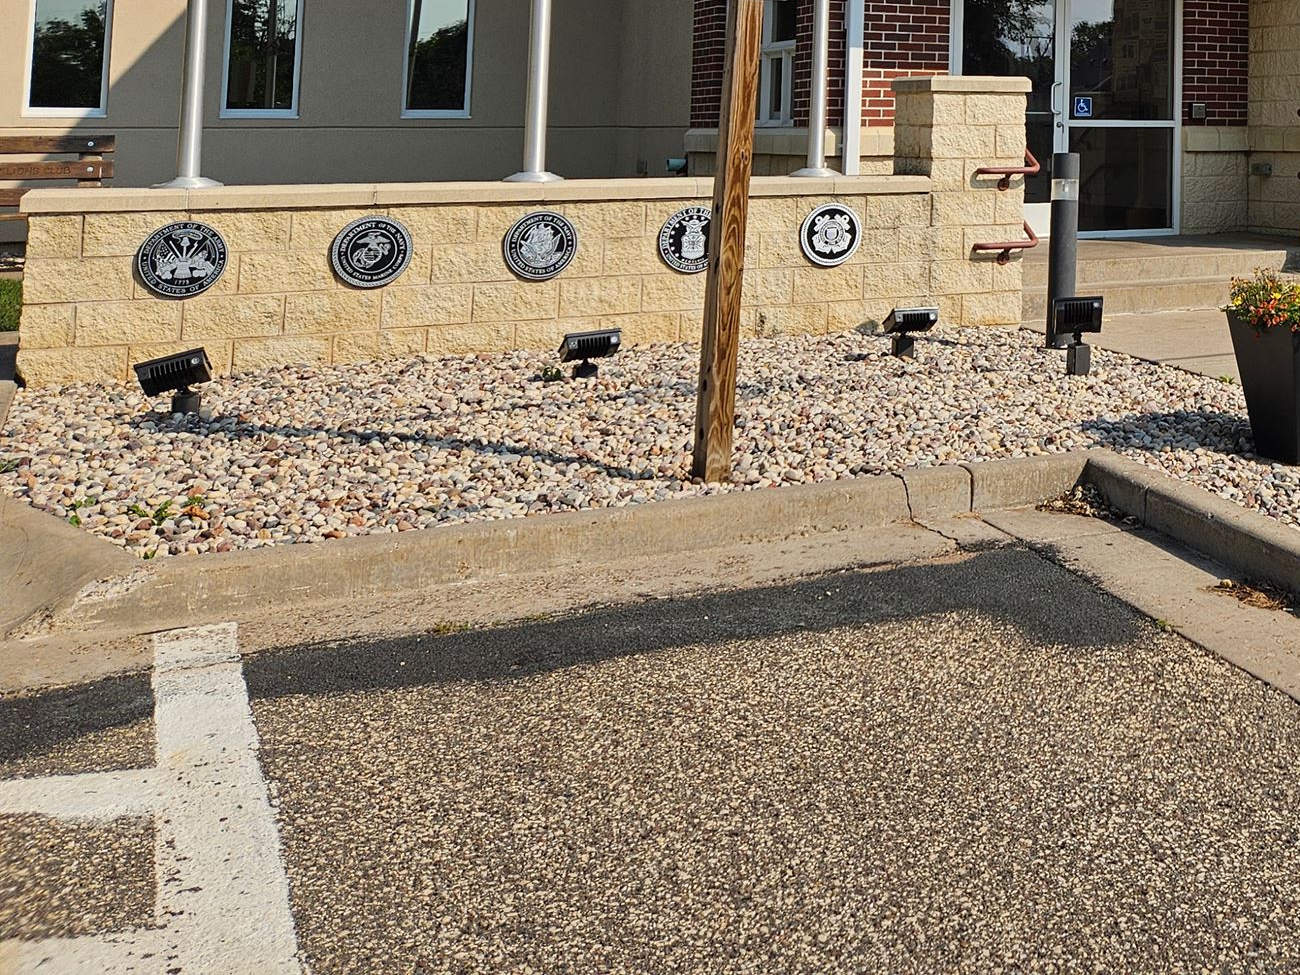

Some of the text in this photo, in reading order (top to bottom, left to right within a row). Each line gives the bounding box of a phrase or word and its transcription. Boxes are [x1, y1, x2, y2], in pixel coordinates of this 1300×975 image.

[144, 224, 184, 254] DEPARTMENT
[200, 226, 214, 237] THE
[213, 236, 225, 253] ARMY
[340, 222, 377, 252] DEPARTMENT
[395, 232, 406, 250] NAVY
[511, 215, 544, 242] DEPARTMENT
[142, 259, 225, 294] UNITED STATES OF AMERICA
